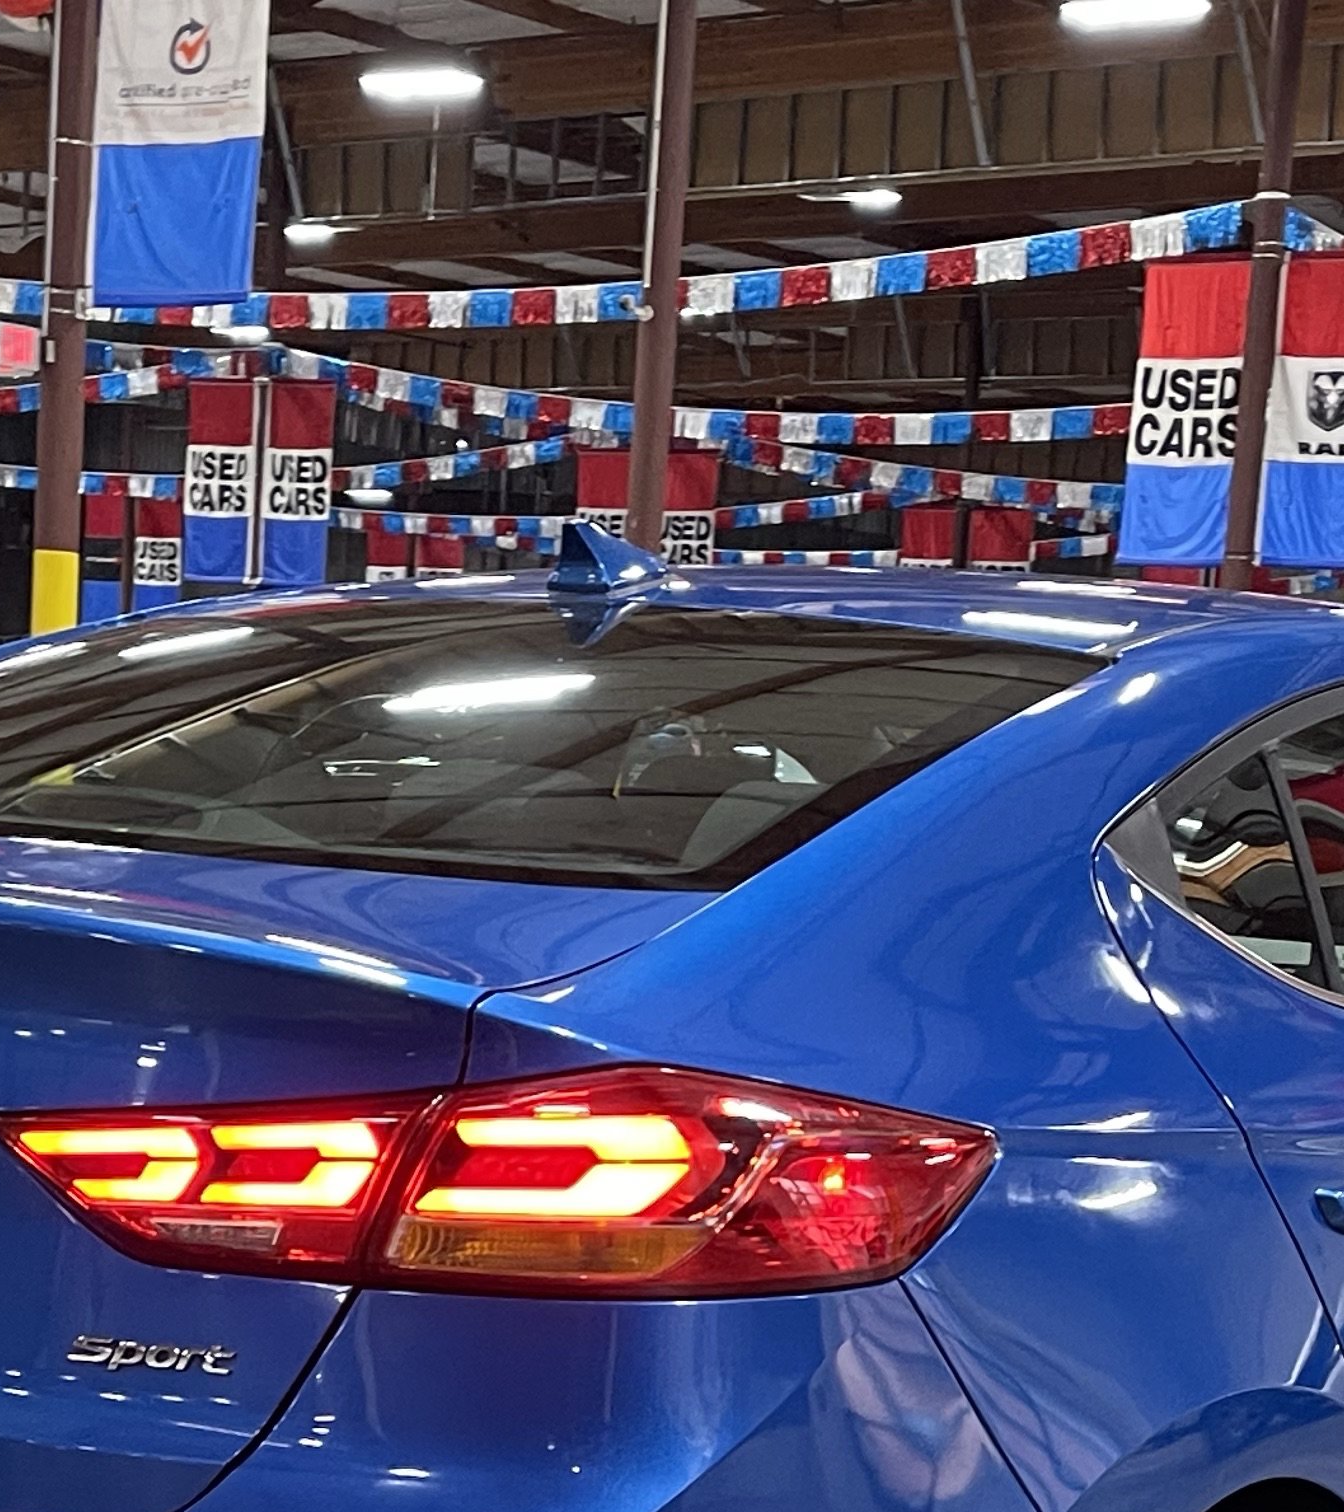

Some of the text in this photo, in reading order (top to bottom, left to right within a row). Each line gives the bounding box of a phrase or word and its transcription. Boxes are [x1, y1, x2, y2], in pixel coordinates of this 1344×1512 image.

[1141, 367, 1242, 411] USED
[1134, 413, 1237, 458] CARS
[192, 451, 247, 480] USED
[272, 453, 327, 484] USED
[189, 483, 247, 511] CARS
[269, 486, 327, 516] CARS
[67, 1335, 237, 1376] Sport
